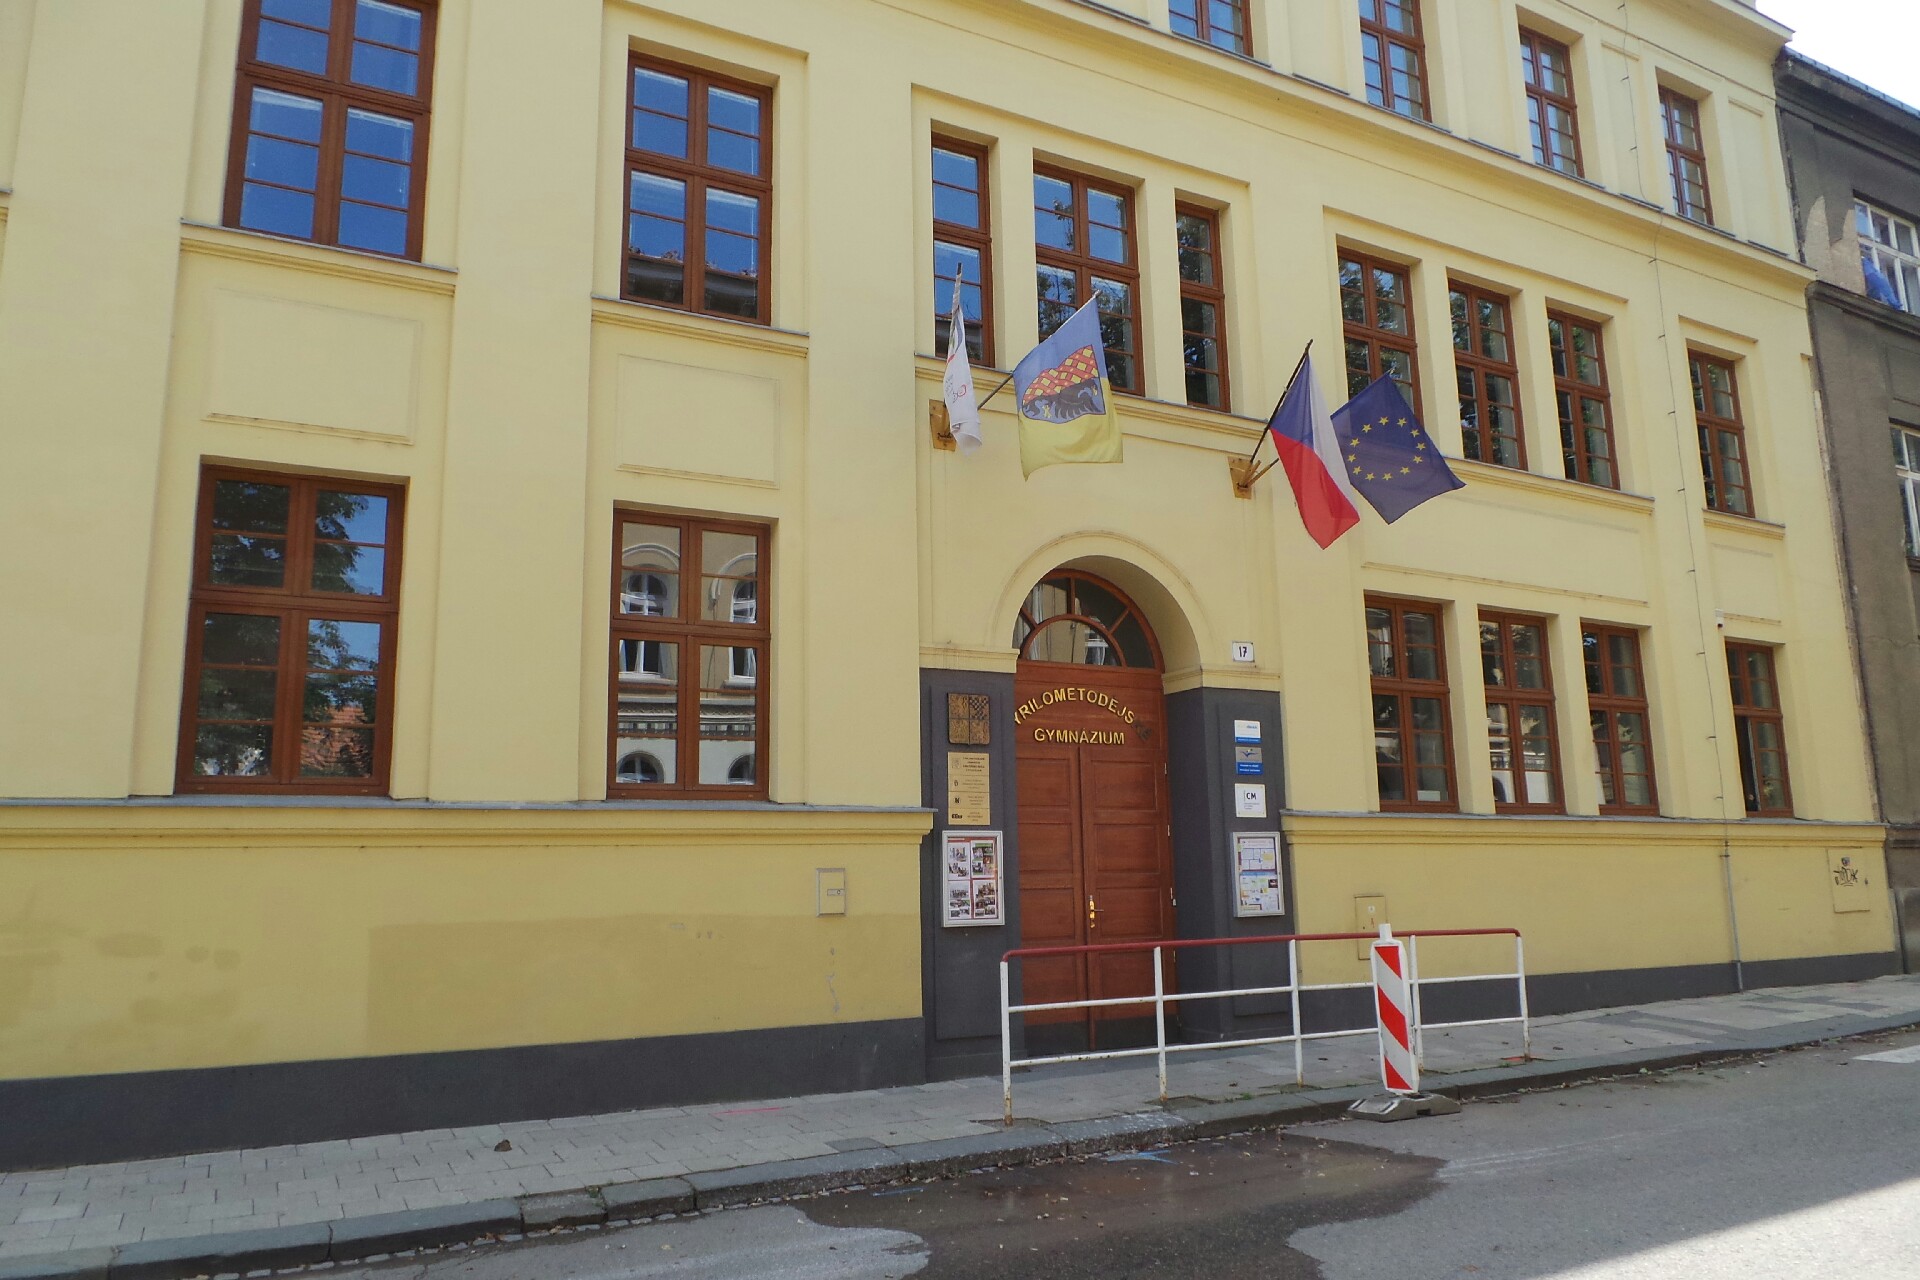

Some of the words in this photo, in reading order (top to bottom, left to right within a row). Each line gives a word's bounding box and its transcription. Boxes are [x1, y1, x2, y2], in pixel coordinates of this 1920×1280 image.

[1238, 645, 1248, 658] 17
[1034, 727, 1125, 745] GYMNÁZIUM
[1246, 792, 1257, 800] CM
